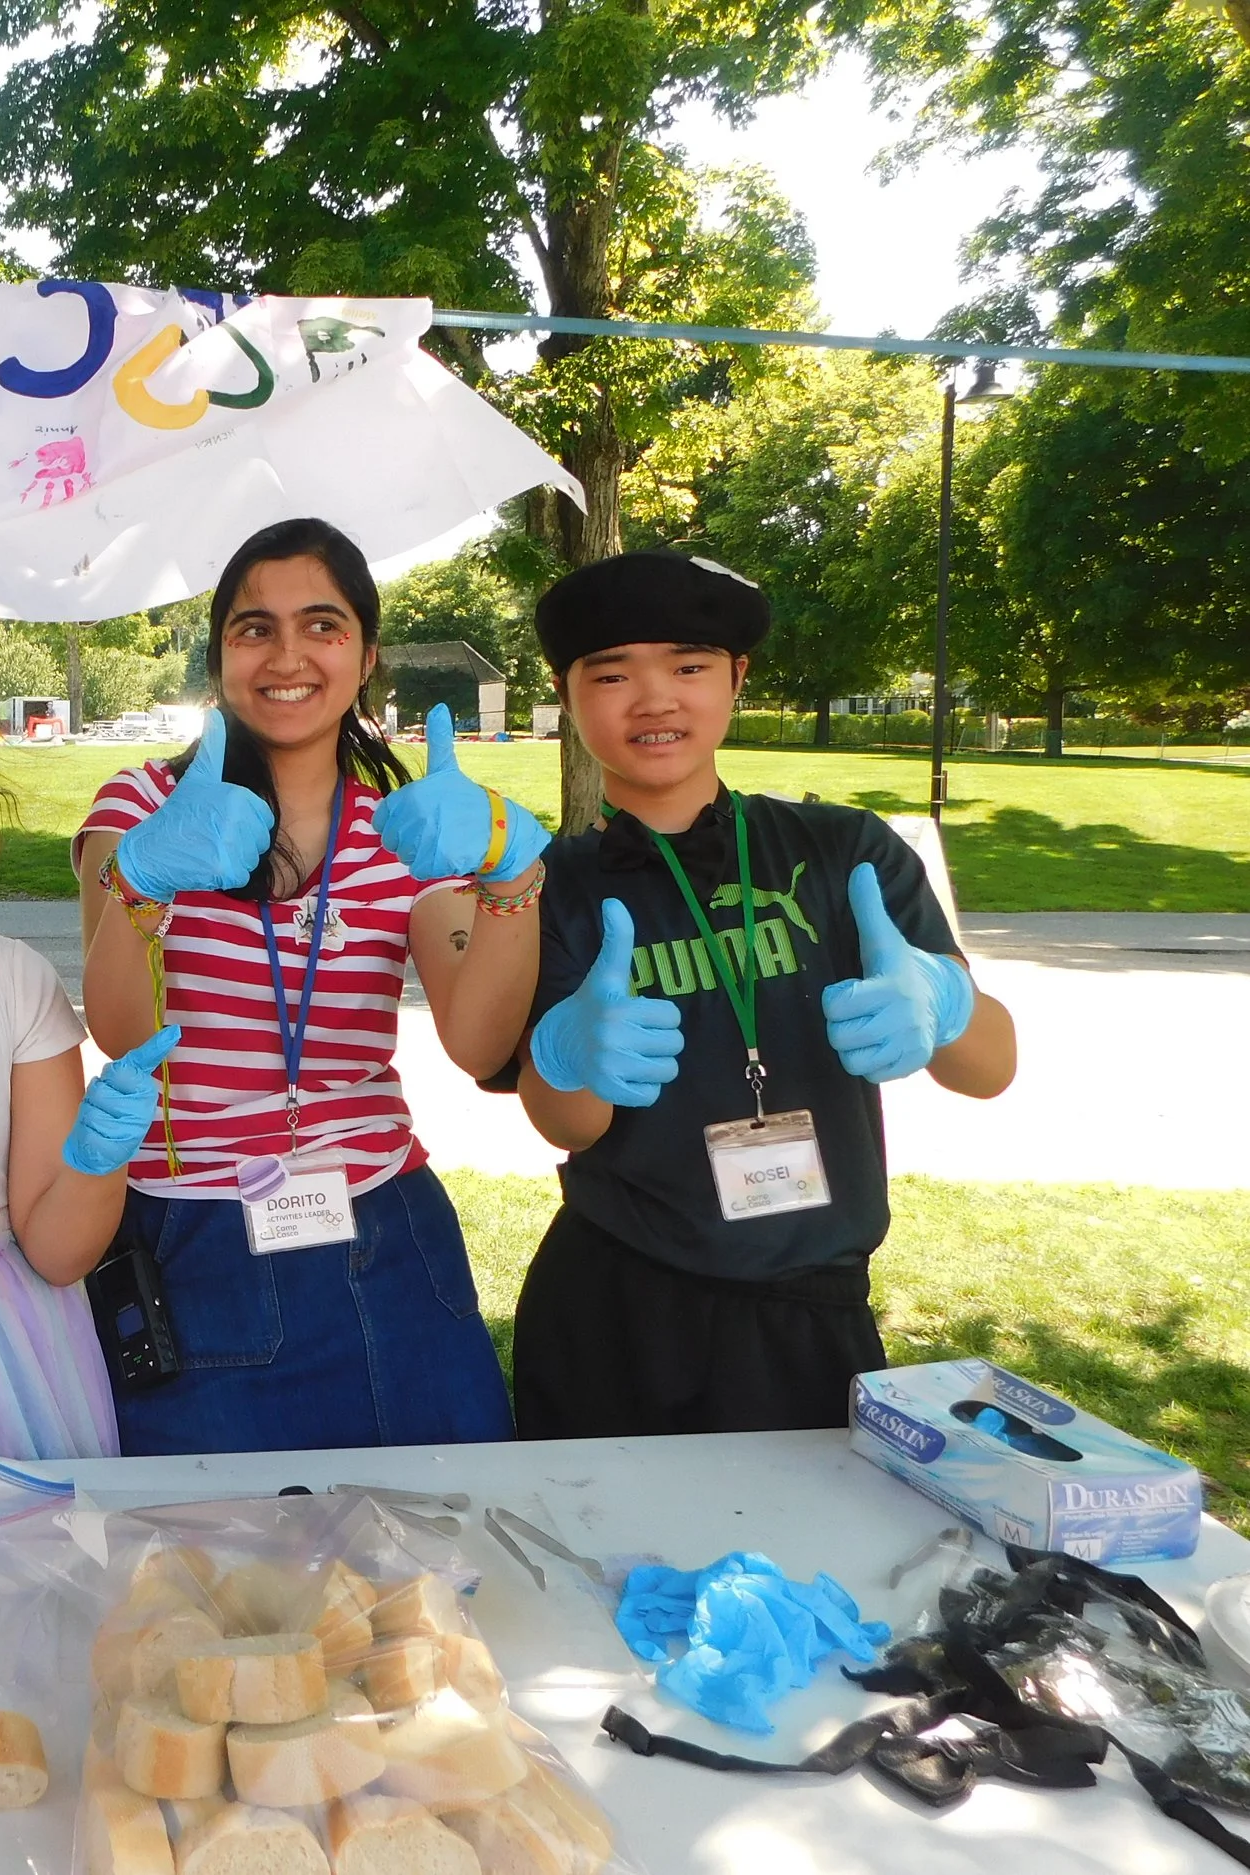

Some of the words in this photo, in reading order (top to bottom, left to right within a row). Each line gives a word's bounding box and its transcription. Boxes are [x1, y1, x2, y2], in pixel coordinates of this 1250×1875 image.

[295, 903, 338, 928] PAIS
[744, 1166, 790, 1185] KOSEI
[267, 1193, 326, 1211] DORITO
[267, 1213, 303, 1222] ACTIVITIES
[305, 1210, 330, 1218] LEADER
[276, 1224, 297, 1233] Camp
[277, 1231, 299, 1239] Casco
[1004, 1521, 1022, 1545] M
